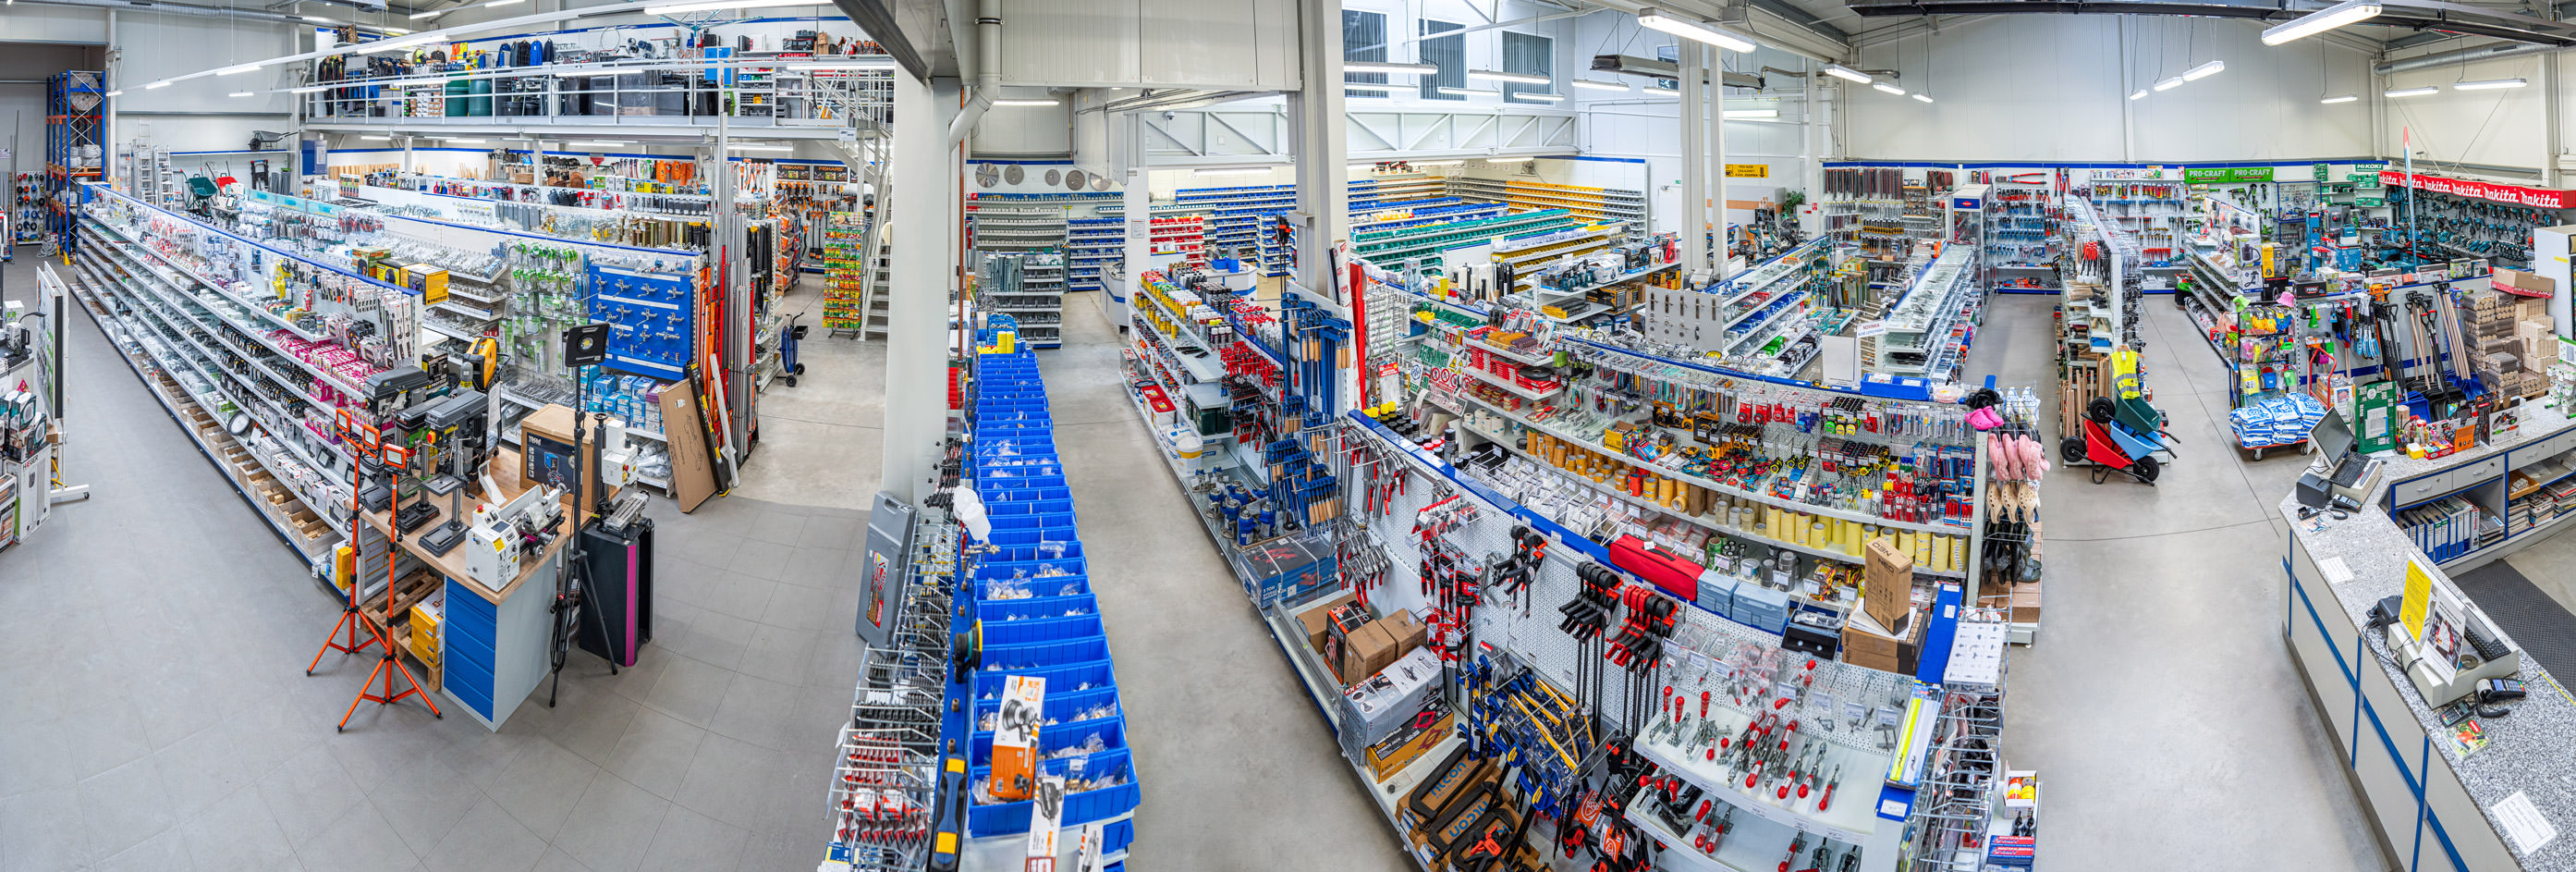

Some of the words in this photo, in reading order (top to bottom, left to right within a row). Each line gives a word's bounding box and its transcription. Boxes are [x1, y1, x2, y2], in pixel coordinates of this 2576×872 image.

[2189, 168, 2227, 178] PRO-CRAFT
[2234, 168, 2271, 177] PRO-CRAFT
[2379, 173, 2399, 185] akita
[1872, 542, 1892, 557] NEO
[1877, 557, 1895, 574] NEO
[1355, 606, 1370, 621] NEO
